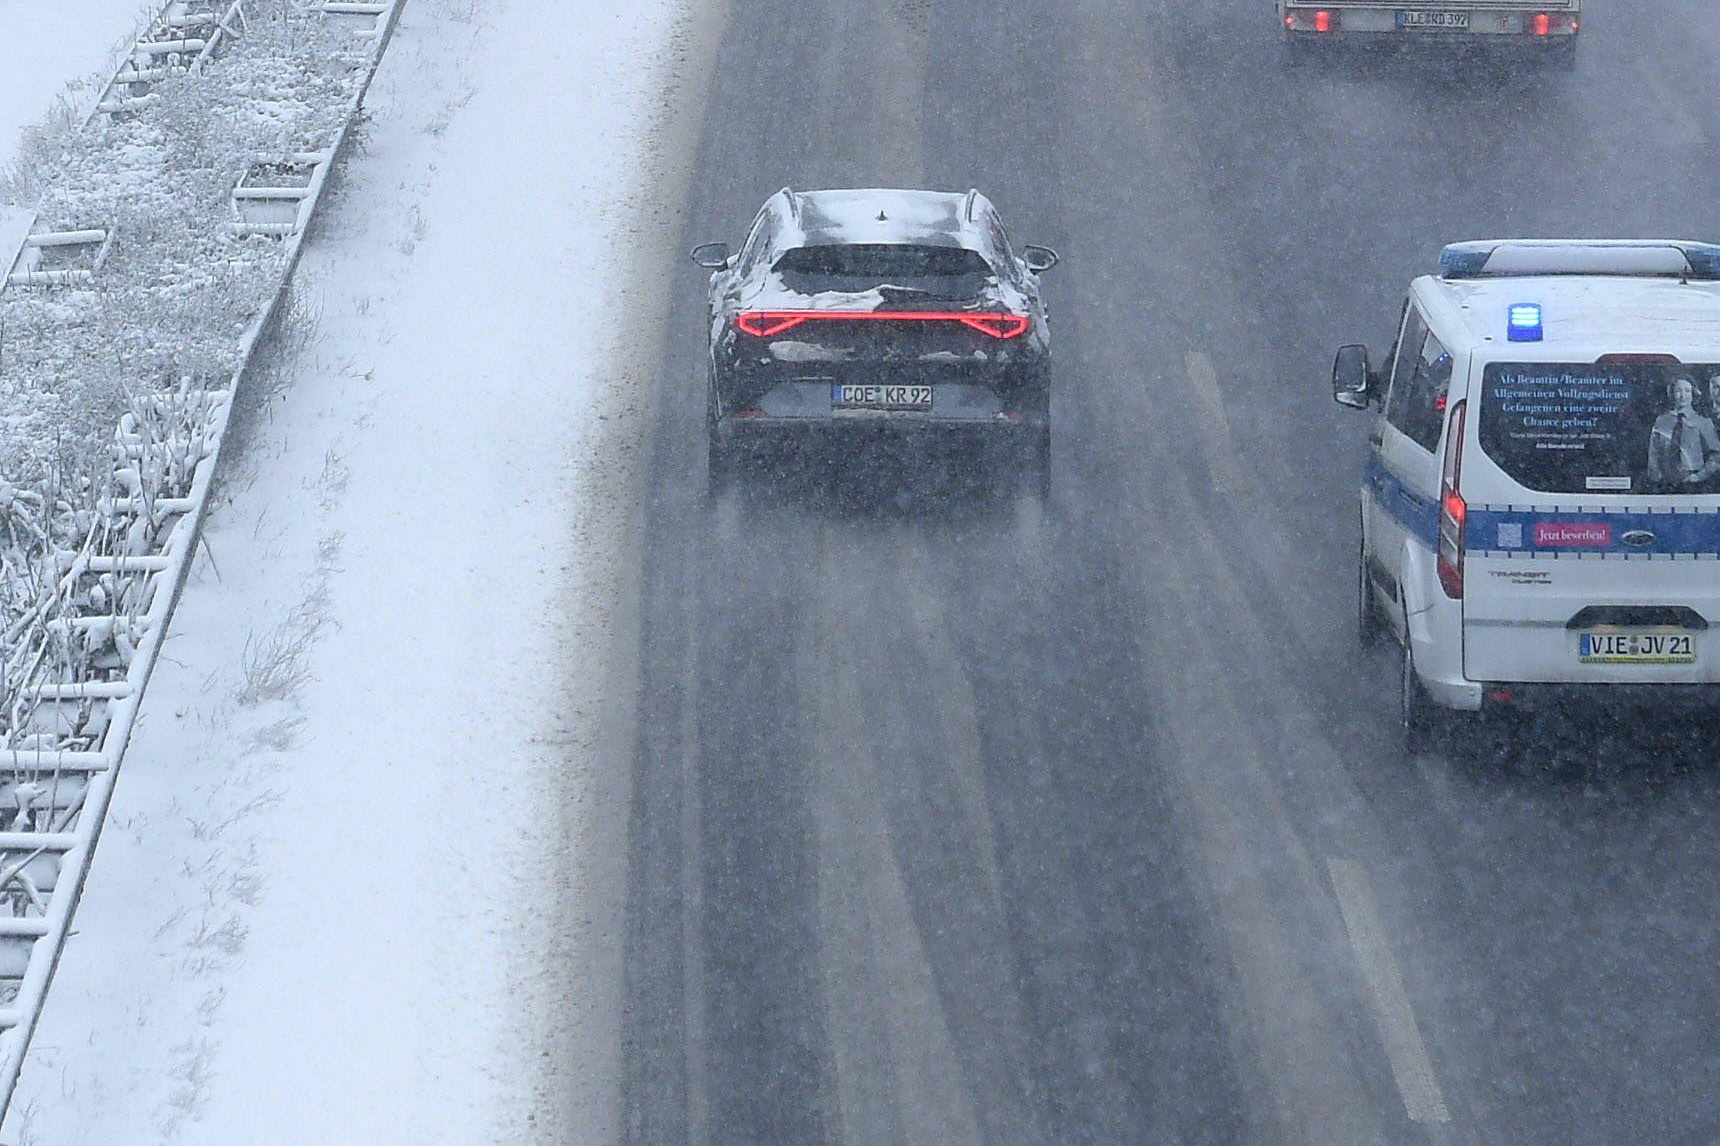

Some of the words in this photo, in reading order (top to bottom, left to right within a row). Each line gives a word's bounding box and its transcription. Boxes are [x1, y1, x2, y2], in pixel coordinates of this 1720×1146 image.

[842, 386, 875, 403] COE
[885, 387, 907, 404] KR
[910, 387, 931, 404] 92
[1538, 529, 1560, 542] Jetzt
[1561, 530, 1606, 541] bewerben!
[1591, 636, 1628, 654] VIE
[1641, 636, 1665, 654] JV
[1669, 636, 1692, 654] 21
